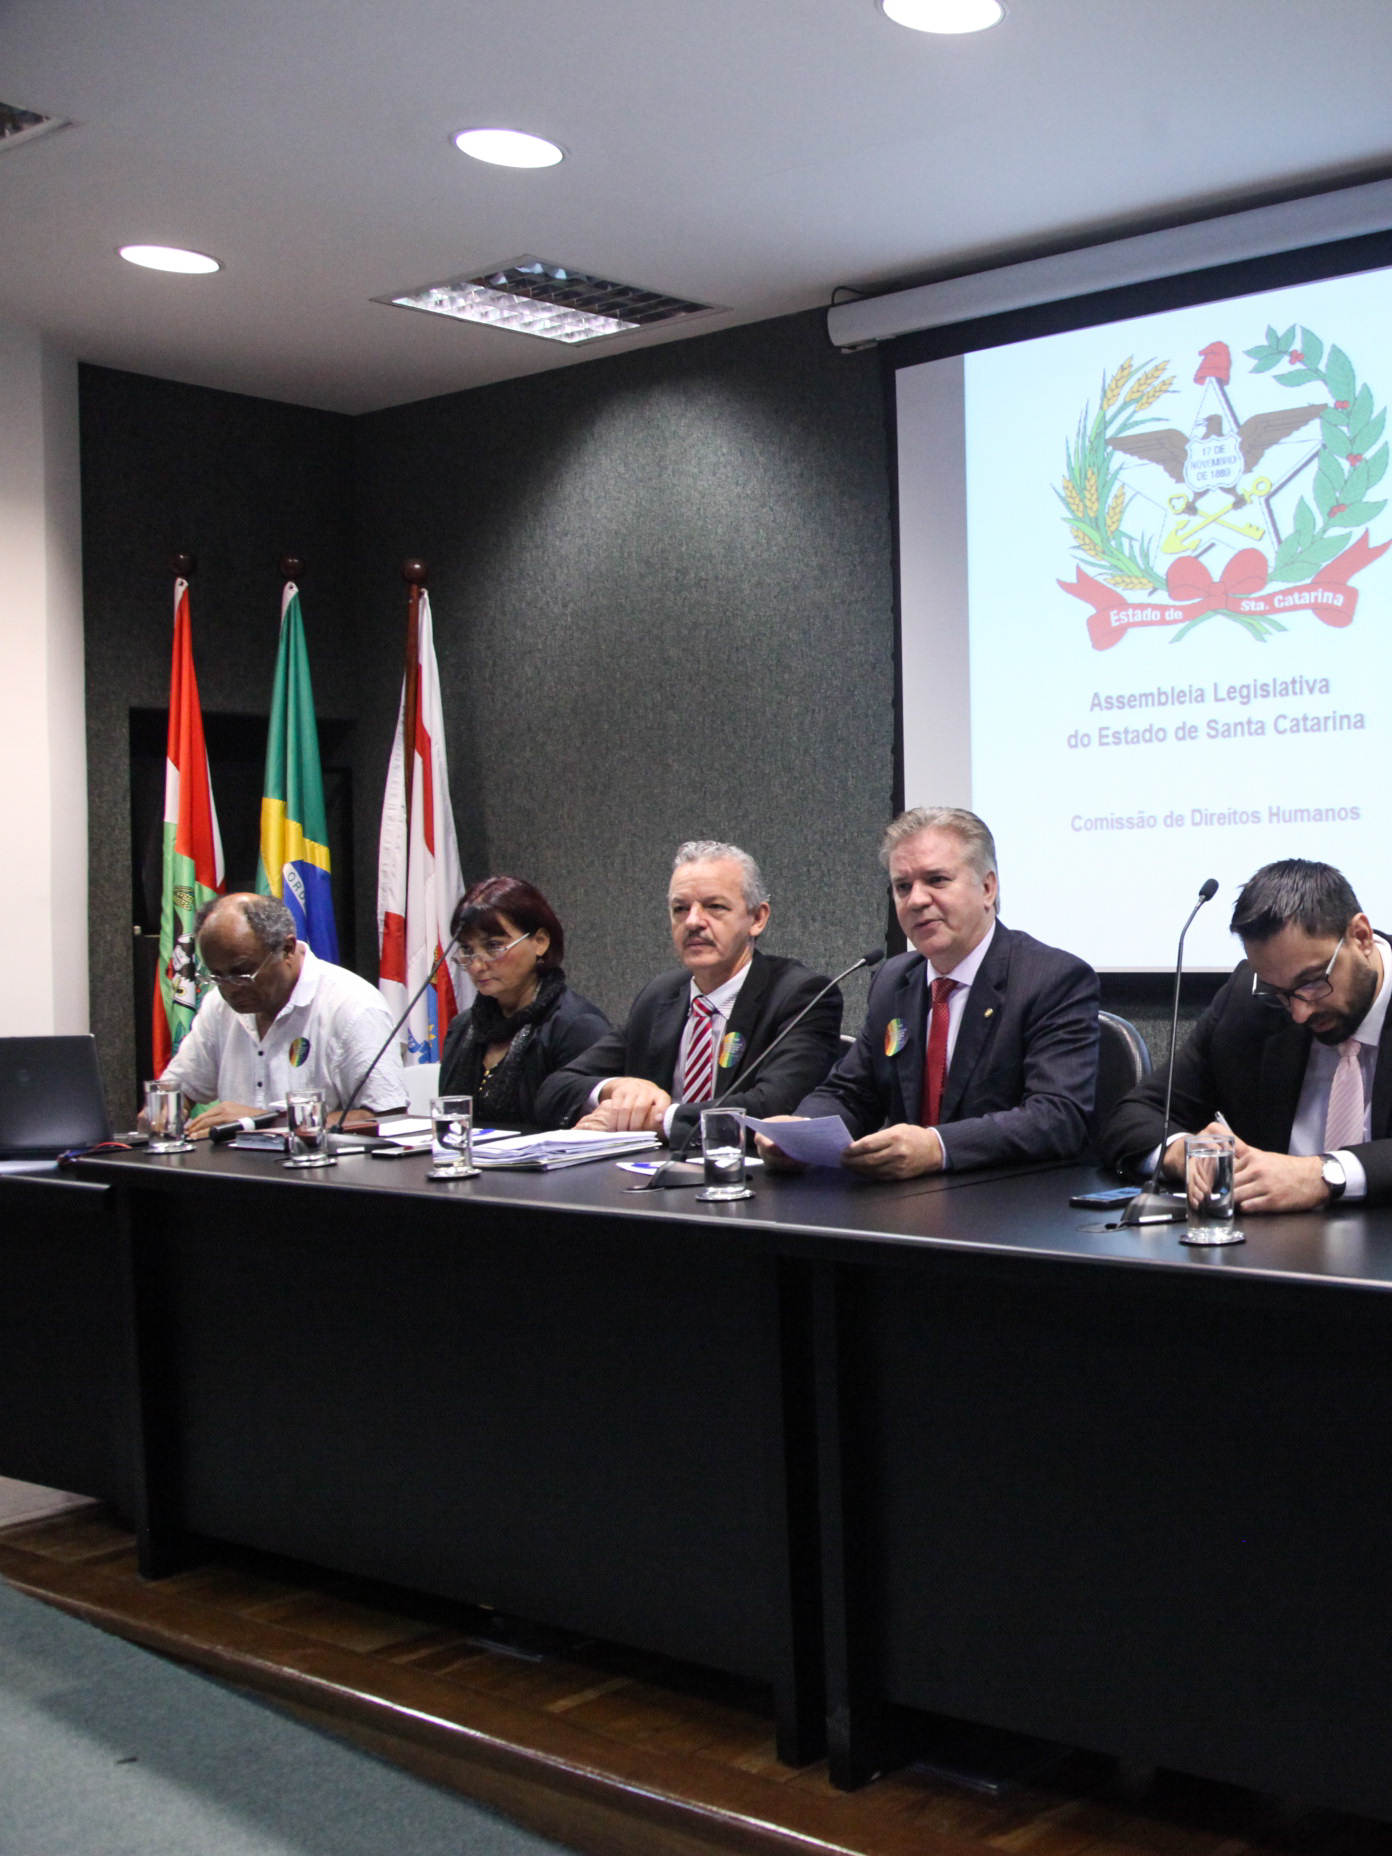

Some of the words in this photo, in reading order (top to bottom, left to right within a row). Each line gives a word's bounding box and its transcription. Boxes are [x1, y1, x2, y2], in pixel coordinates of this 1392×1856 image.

[1214, 444, 1225, 454] DE
[1197, 471, 1208, 481] DE
[1109, 608, 1161, 627] Estado
[1165, 607, 1183, 620] de
[1240, 599, 1270, 612] Sta.
[1273, 588, 1344, 609] Catarina
[1089, 684, 1206, 712] Assembleia
[1213, 675, 1331, 706] Legislativa
[1067, 729, 1091, 749] do
[1098, 723, 1167, 747] Estado
[1174, 721, 1199, 741] de
[1206, 716, 1266, 739] Santa
[1273, 710, 1366, 735] Catarina
[1071, 811, 1157, 832] Comissão
[1163, 810, 1185, 828] de
[1190, 807, 1262, 827] Direitos
[1268, 805, 1361, 824] Humanos
